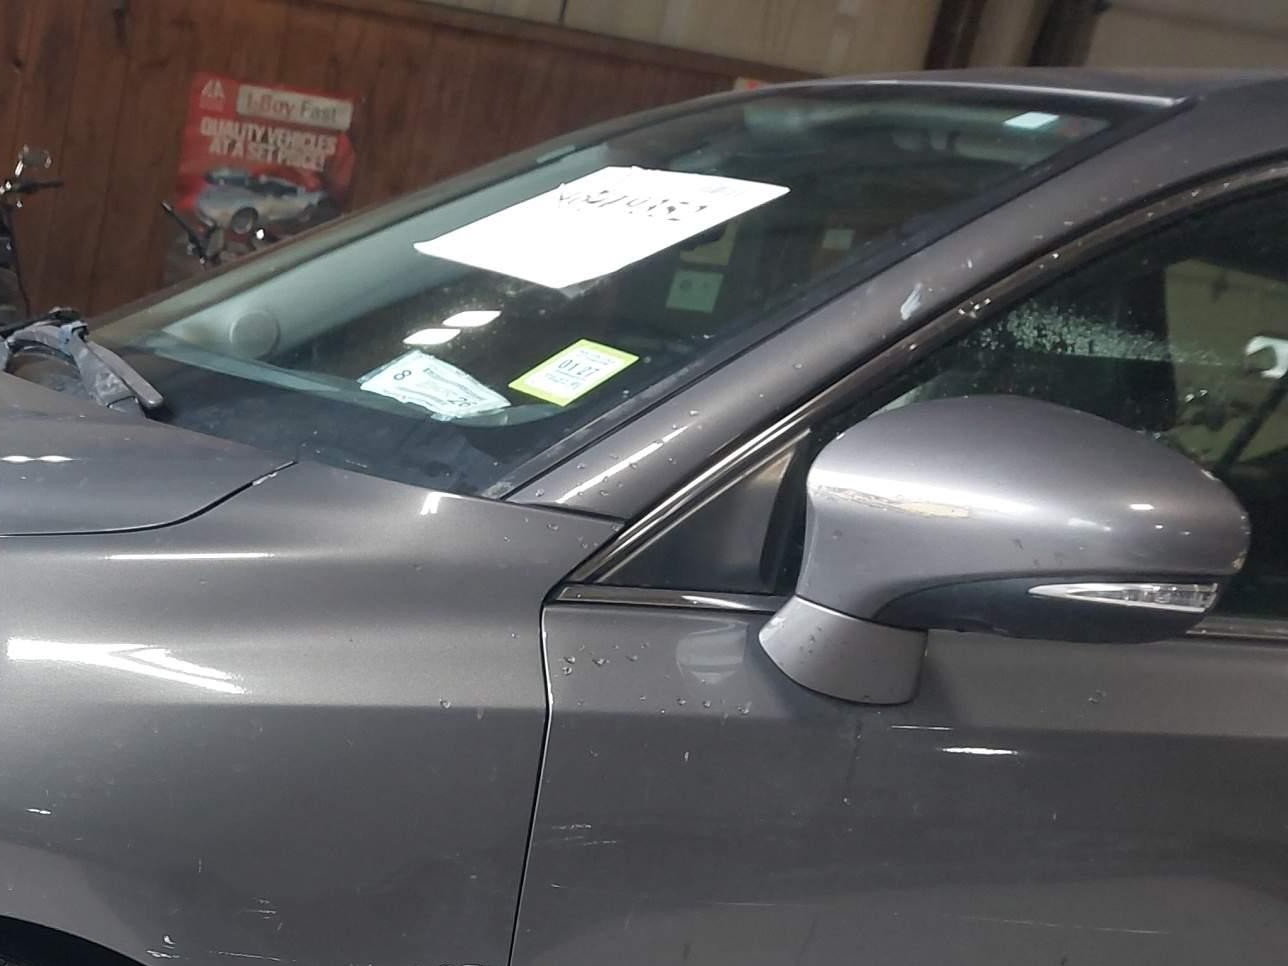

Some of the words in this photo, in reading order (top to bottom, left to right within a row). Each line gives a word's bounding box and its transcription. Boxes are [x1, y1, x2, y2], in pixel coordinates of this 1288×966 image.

[299, 99, 338, 124] Fast
[199, 116, 266, 145] QUALITY
[265, 125, 339, 155] VEHICLES
